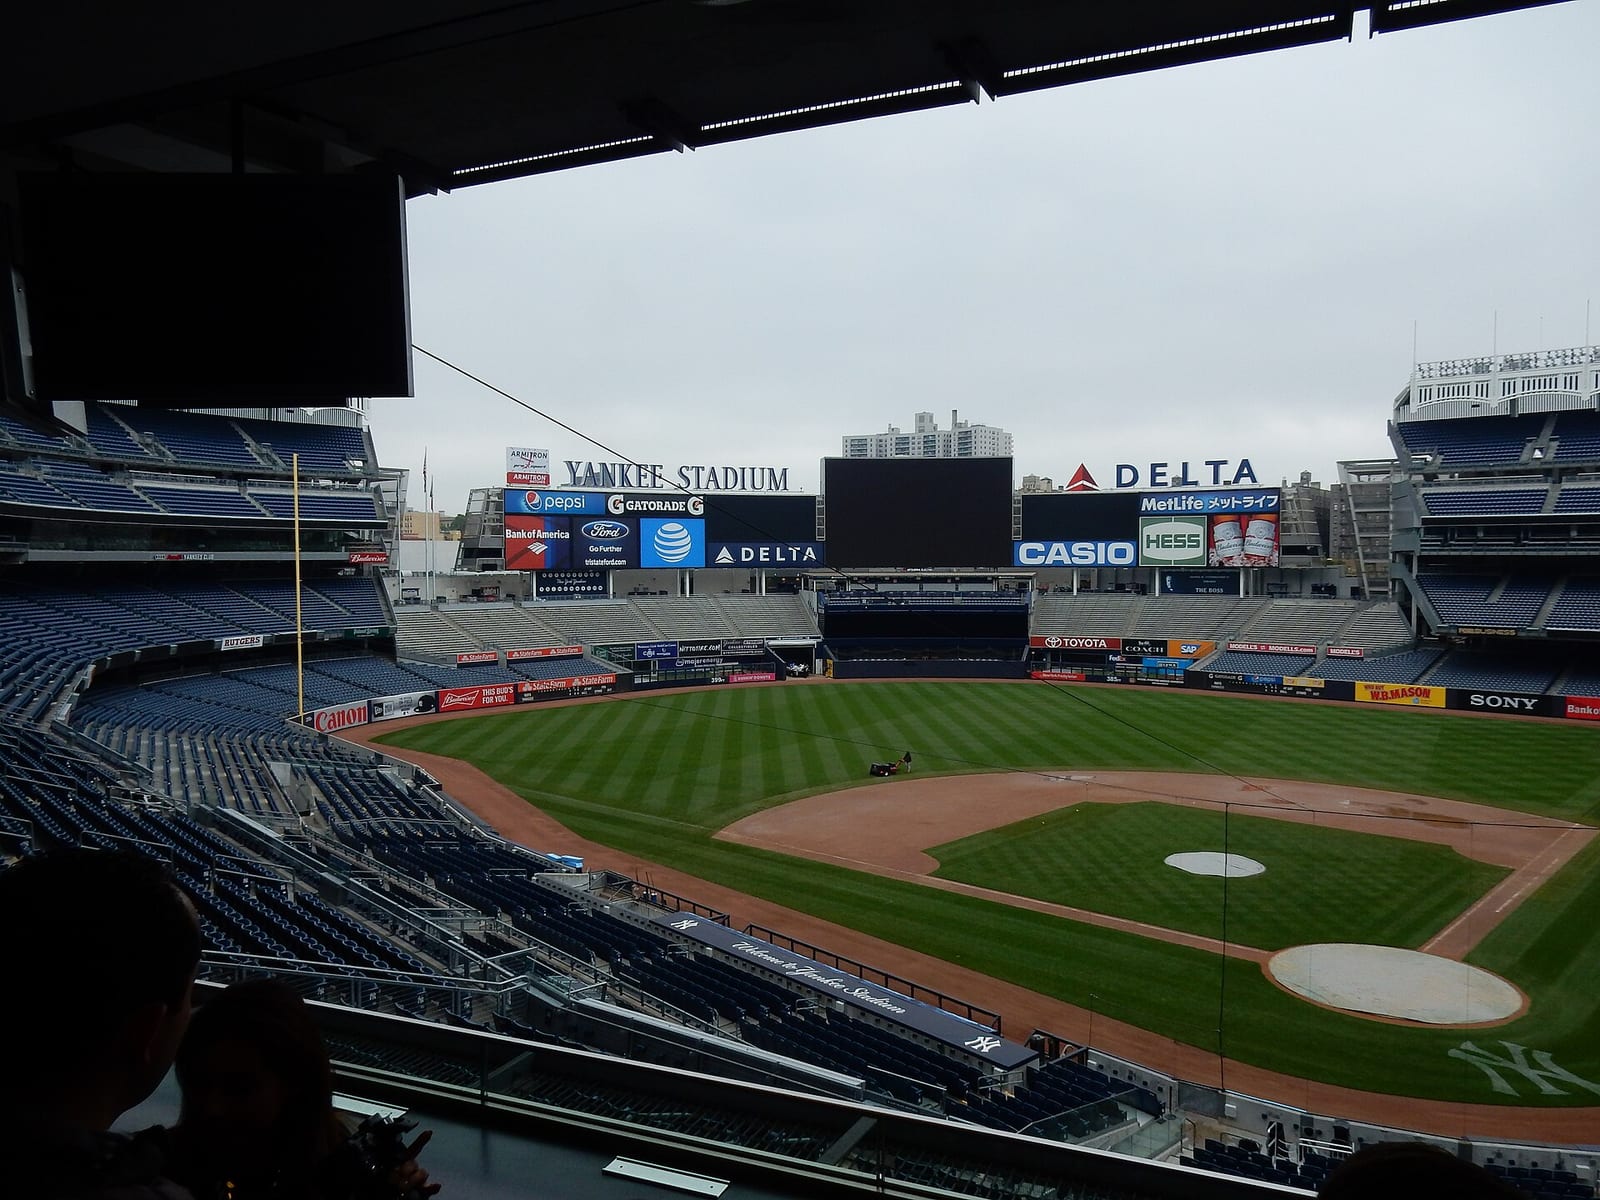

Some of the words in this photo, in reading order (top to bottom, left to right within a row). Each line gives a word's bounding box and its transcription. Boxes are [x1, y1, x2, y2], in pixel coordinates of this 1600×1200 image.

[511, 450, 548, 459] ARMITRON
[563, 460, 664, 489] YANKEE
[677, 465, 789, 491] STADIUM
[1116, 458, 1258, 488] DELTA
[544, 495, 585, 512] pepsi
[626, 500, 686, 512] GATORADE
[1141, 495, 1204, 511] MetLife
[1208, 495, 1279, 509] メットライフ
[505, 529, 527, 539] Bank
[527, 529, 537, 539] of
[536, 529, 570, 540] America
[590, 523, 621, 538] Ford
[1146, 534, 1201, 549] HESS
[599, 545, 623, 553] Further
[741, 547, 817, 562] DELTA
[1019, 542, 1135, 565] CASIO
[350, 554, 386, 562] Budweiser
[585, 558, 627, 566] tristateford.com
[224, 636, 261, 647] RUTGERS
[1063, 638, 1107, 648] TOYOTA
[1125, 645, 1164, 653] COACH
[1180, 645, 1197, 654] SAP
[1108, 654, 1127, 662] FedEx
[482, 687, 496, 696] THIS
[496, 686, 514, 695] BUD'S
[446, 695, 475, 704] Budweiser
[482, 696, 495, 704] FOR
[1470, 694, 1539, 710] SONY
[1567, 704, 1593, 714] Bank
[315, 705, 367, 732] Canon
[732, 941, 784, 965] Welcome
[785, 965, 846, 989] Yankee
[843, 984, 906, 1014] Stadium
